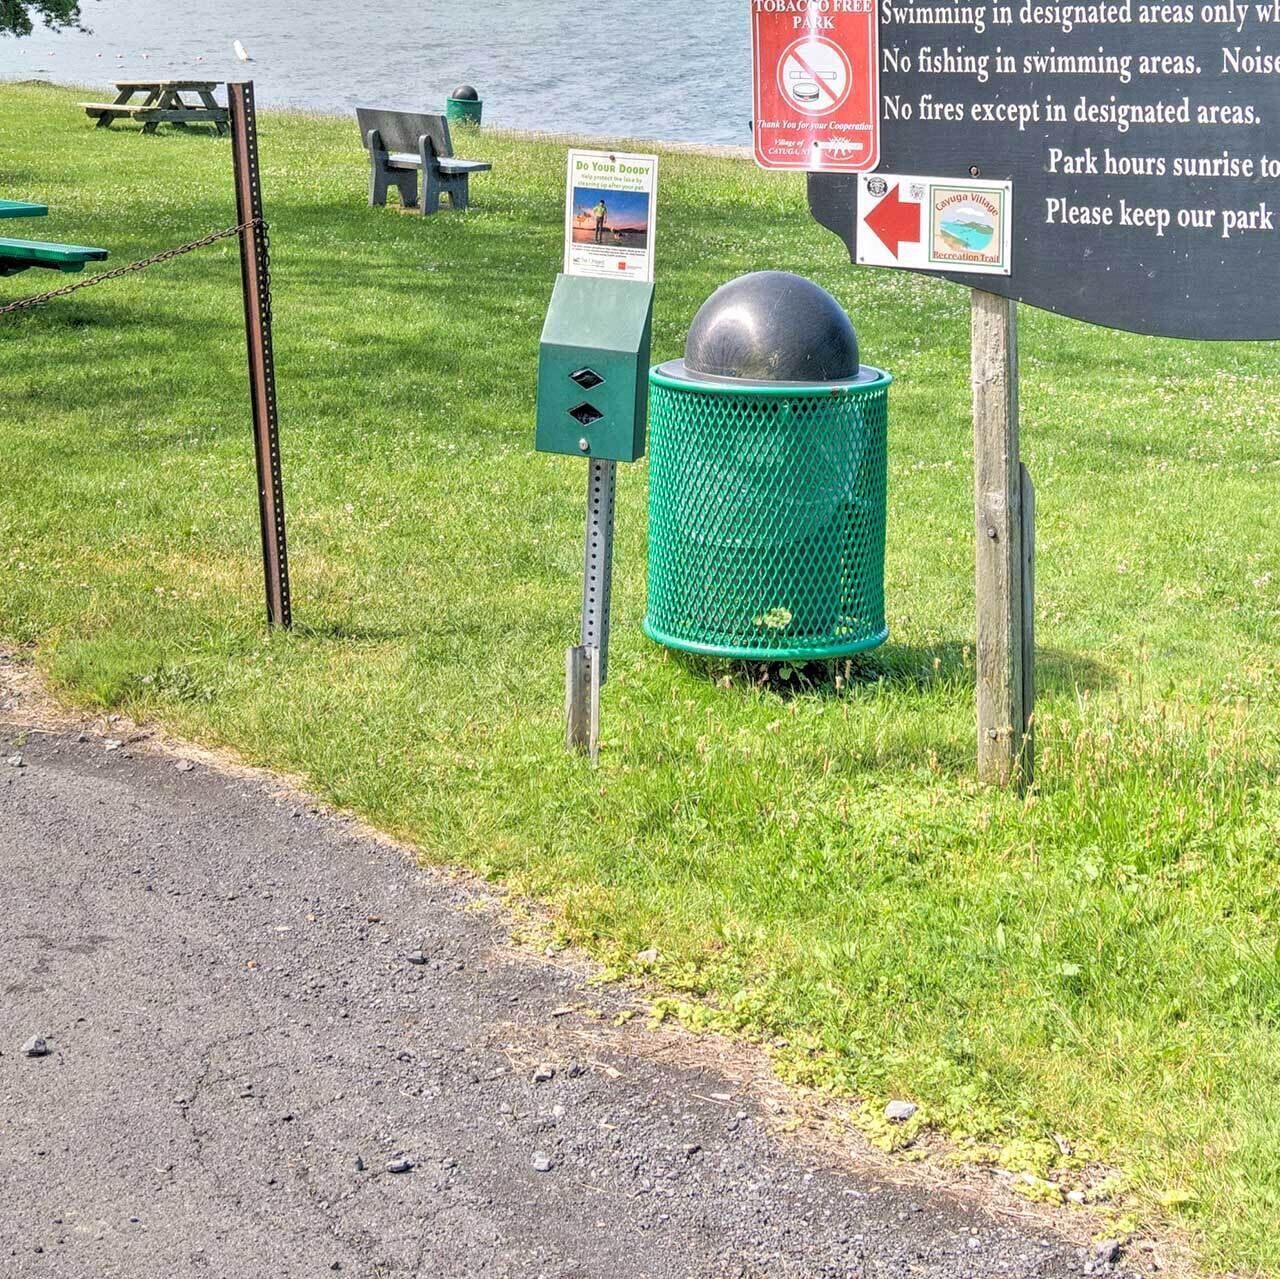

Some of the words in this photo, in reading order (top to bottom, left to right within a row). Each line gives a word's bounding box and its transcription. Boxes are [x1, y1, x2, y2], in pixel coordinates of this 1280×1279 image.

[833, 0, 872, 12] FREE
[1139, 4, 1193, 23] areas
[792, 16, 835, 29] PARK
[882, 48, 911, 73] No
[918, 46, 989, 82] fishing
[995, 46, 1017, 73] in
[1023, 46, 1132, 83] swimming
[1139, 54, 1202, 74] areas.
[883, 95, 912, 120] No
[919, 94, 964, 121] fires
[971, 99, 1039, 131] except
[1045, 95, 1067, 122] in
[1073, 96, 1190, 132] designated
[1197, 105, 1261, 125] areas.
[757, 119, 780, 129] Thank
[782, 120, 797, 129] You
[797, 121, 809, 130] for
[810, 123, 828, 131] your
[829, 121, 873, 132] Cooperation
[1048, 148, 1098, 174] Park
[1104, 148, 1166, 176] hours
[1173, 151, 1254, 177] sunrise
[935, 193, 968, 211] Cayuga
[970, 193, 999, 217] Village
[1046, 198, 1113, 224] Please
[1119, 199, 1170, 236] keep
[1177, 207, 1216, 228] our
[1222, 202, 1273, 238] park
[933, 250, 979, 263] Recreation
[980, 253, 1000, 264] Trail
